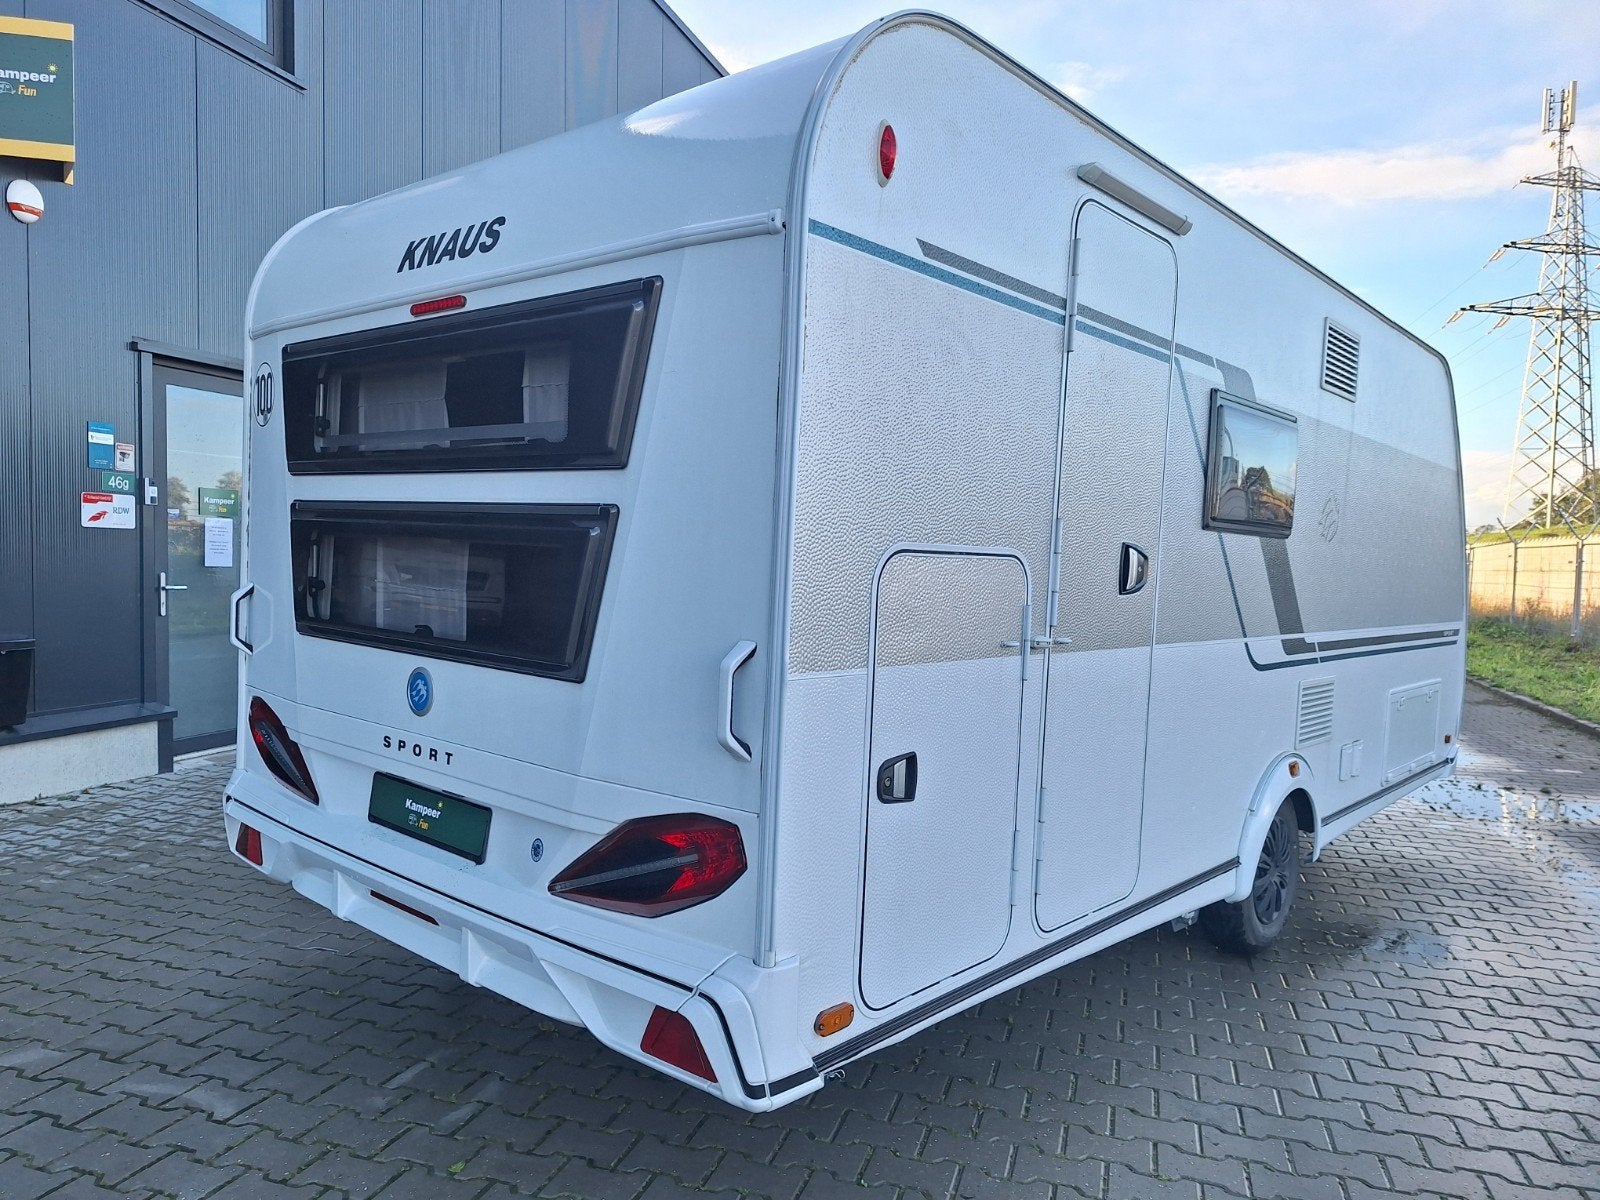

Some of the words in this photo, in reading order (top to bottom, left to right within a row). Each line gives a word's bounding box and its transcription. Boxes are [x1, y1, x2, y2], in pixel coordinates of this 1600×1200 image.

[18, 84, 37, 97] Fun
[397, 216, 507, 274] KNAUS
[255, 372, 273, 417] 100
[108, 475, 129, 491] 46g
[203, 495, 235, 506] Kampeer
[112, 506, 130, 515] RDW
[383, 735, 454, 765] SPORT
[405, 798, 441, 819] Kampeer
